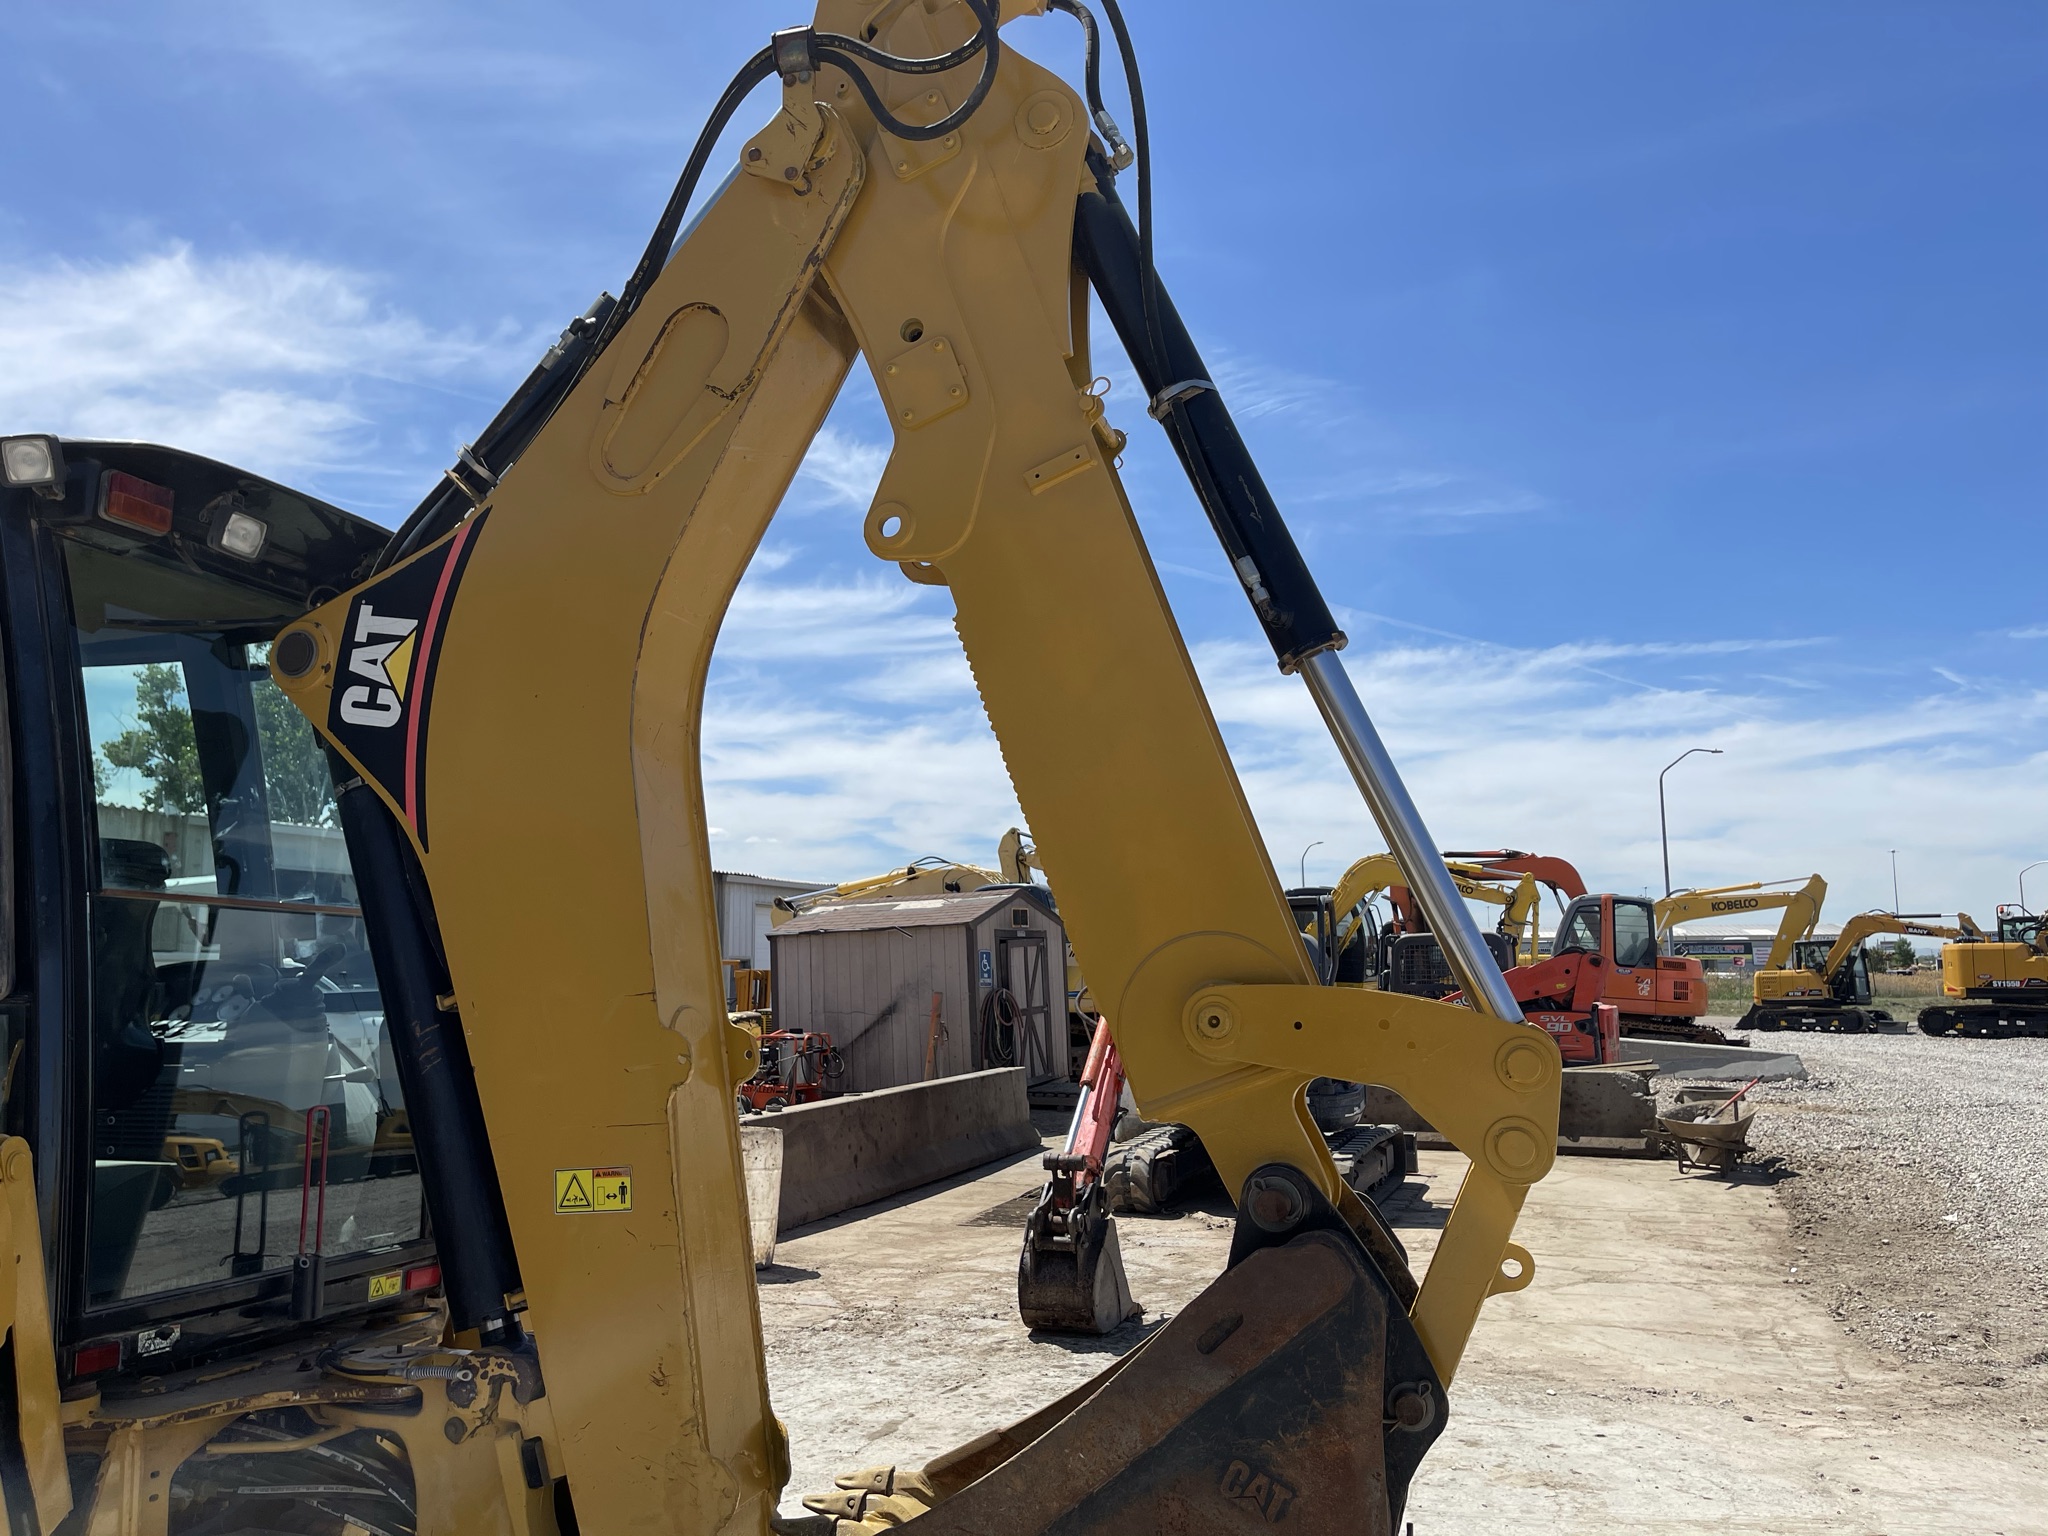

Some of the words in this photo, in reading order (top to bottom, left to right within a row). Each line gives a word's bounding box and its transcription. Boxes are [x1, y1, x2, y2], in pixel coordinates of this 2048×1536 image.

[340, 604, 418, 728] CAT
[1711, 898, 1758, 912] KOBELCO
[1908, 927, 1928, 935] SANY
[1546, 1022, 1572, 1033] 90
[1221, 1460, 1293, 1523] CAT
